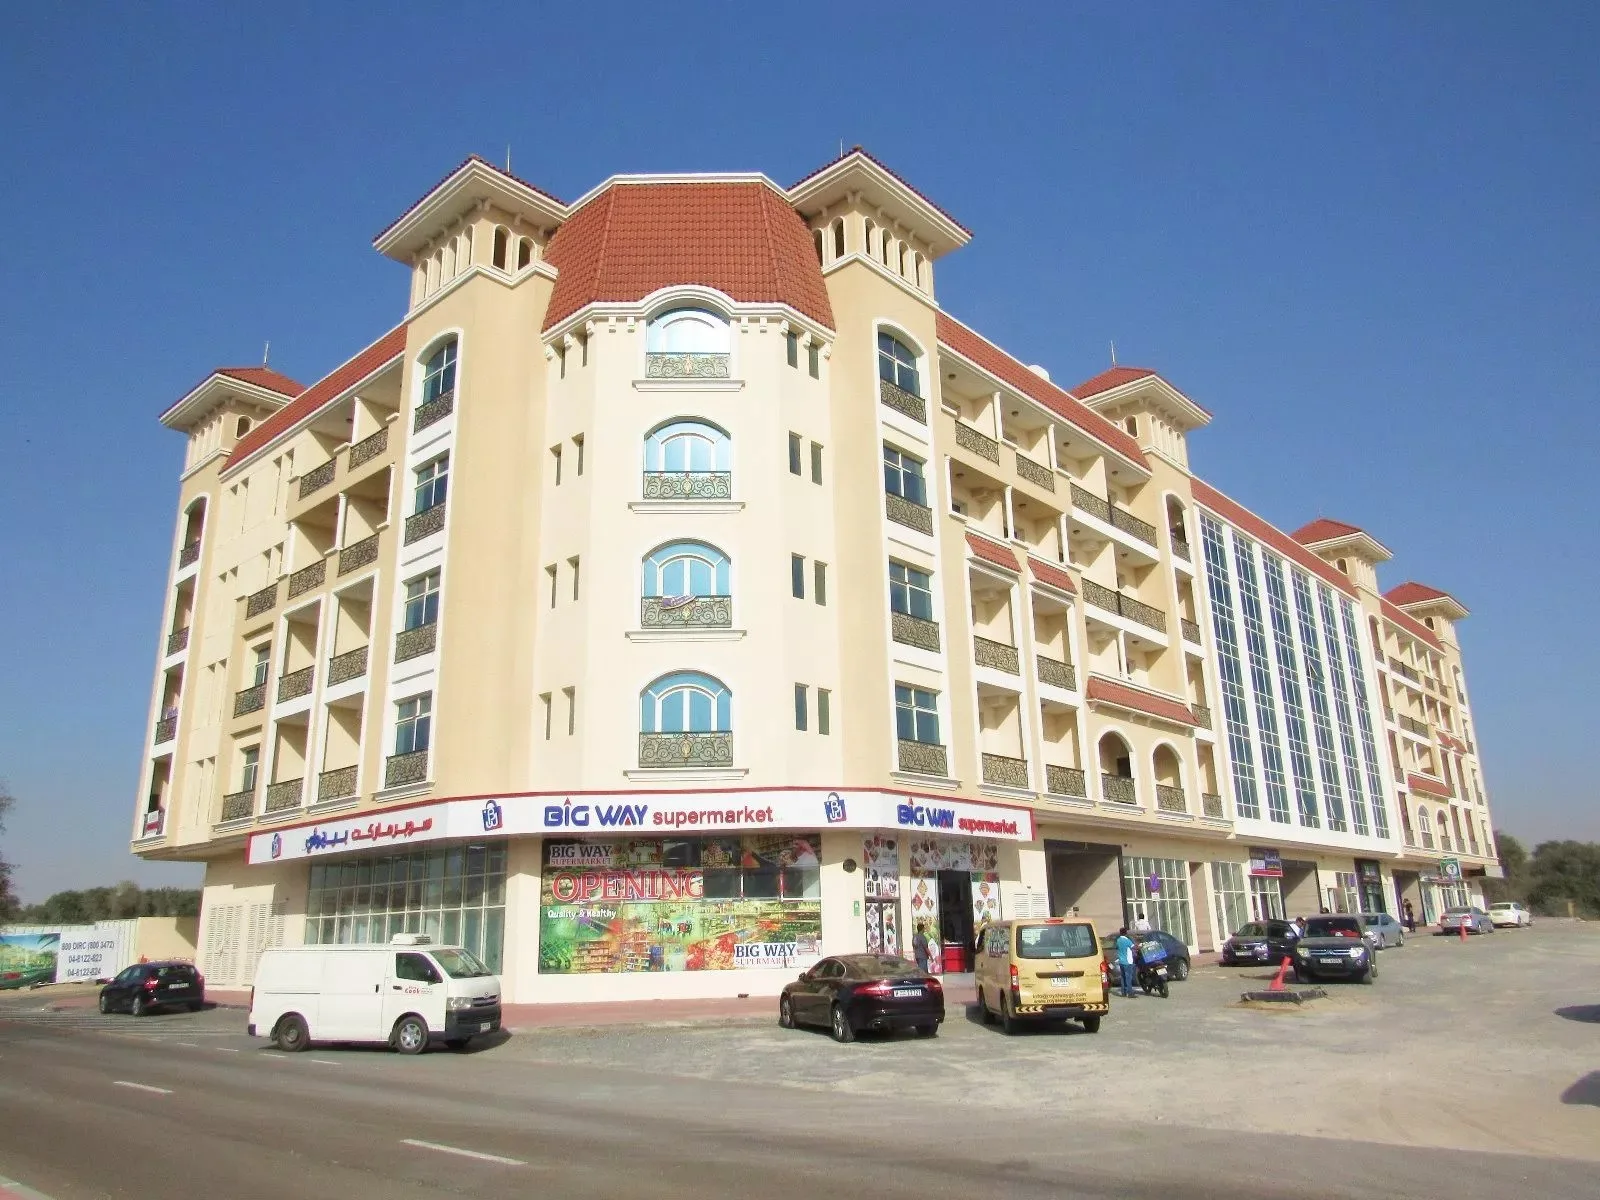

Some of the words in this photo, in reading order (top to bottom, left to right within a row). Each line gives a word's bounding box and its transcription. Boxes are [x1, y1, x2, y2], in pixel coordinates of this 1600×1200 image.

[544, 798, 590, 827] BIG
[595, 805, 649, 827] WAY
[652, 806, 774, 828] supermarket
[925, 807, 955, 829] WAY
[958, 817, 1018, 835] supermarket
[551, 846, 575, 858] BIG
[579, 845, 612, 857] WAY
[551, 857, 612, 866] SUPERMARKET
[552, 869, 704, 901] OPENING
[548, 909, 576, 919] Quality
[579, 910, 585, 918] &
[587, 909, 617, 920] Healthy
[735, 945, 760, 958] BIG
[764, 943, 797, 957] WAY
